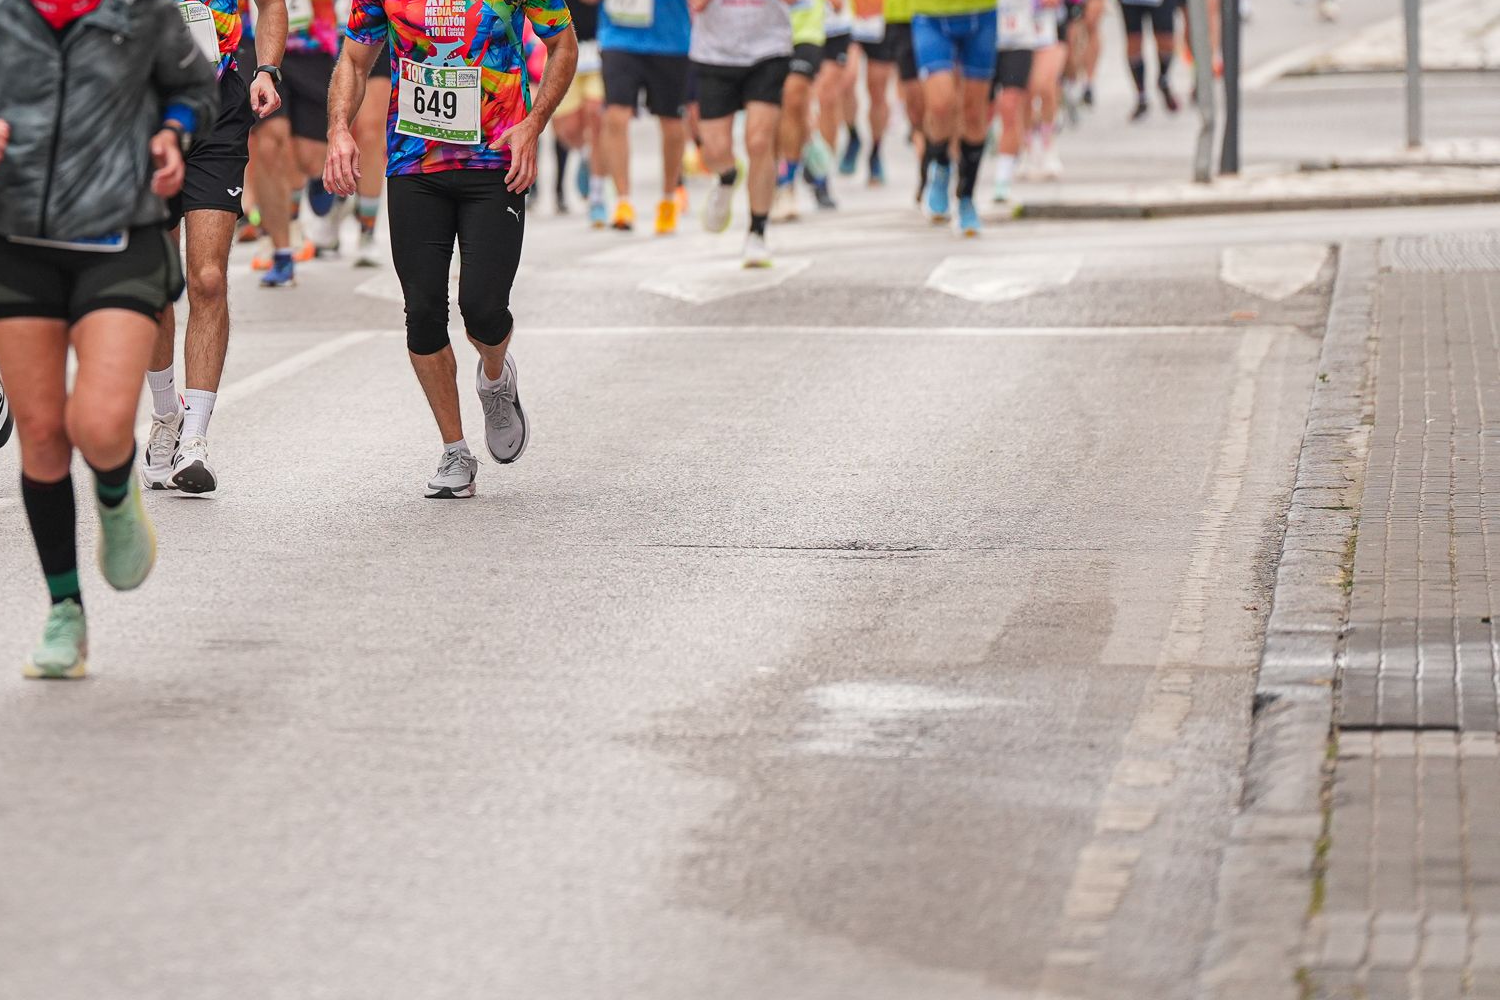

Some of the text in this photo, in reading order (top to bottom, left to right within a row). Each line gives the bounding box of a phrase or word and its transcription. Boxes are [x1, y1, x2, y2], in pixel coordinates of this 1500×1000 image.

[425, 6, 452, 16] MEDIA
[425, 15, 466, 27] MARATÓN
[431, 27, 447, 37] 10K
[406, 63, 427, 85] 10K
[414, 86, 457, 119] 649
